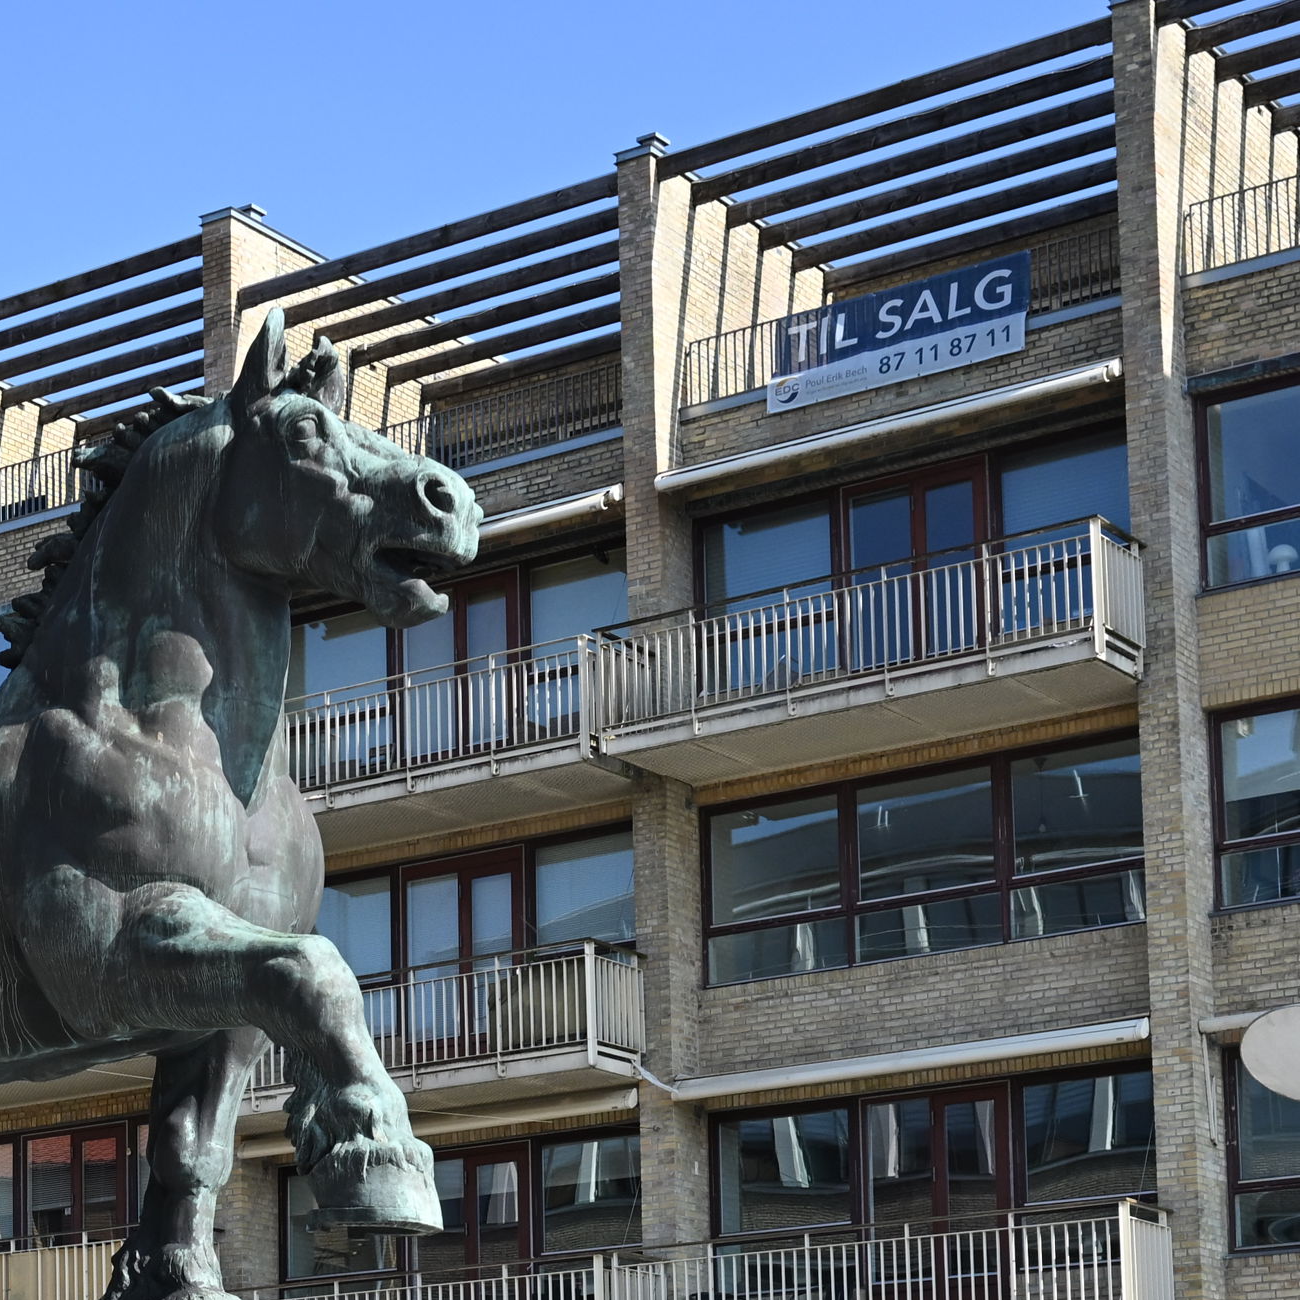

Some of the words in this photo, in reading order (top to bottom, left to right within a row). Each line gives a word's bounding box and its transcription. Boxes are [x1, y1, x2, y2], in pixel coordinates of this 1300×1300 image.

[788, 312, 858, 363] TIL
[875, 268, 1013, 340] SALG
[878, 351, 906, 374] 87
[915, 343, 939, 365] 11
[949, 333, 977, 357] 87
[986, 324, 1011, 347] 11
[775, 383, 800, 396] EDC
